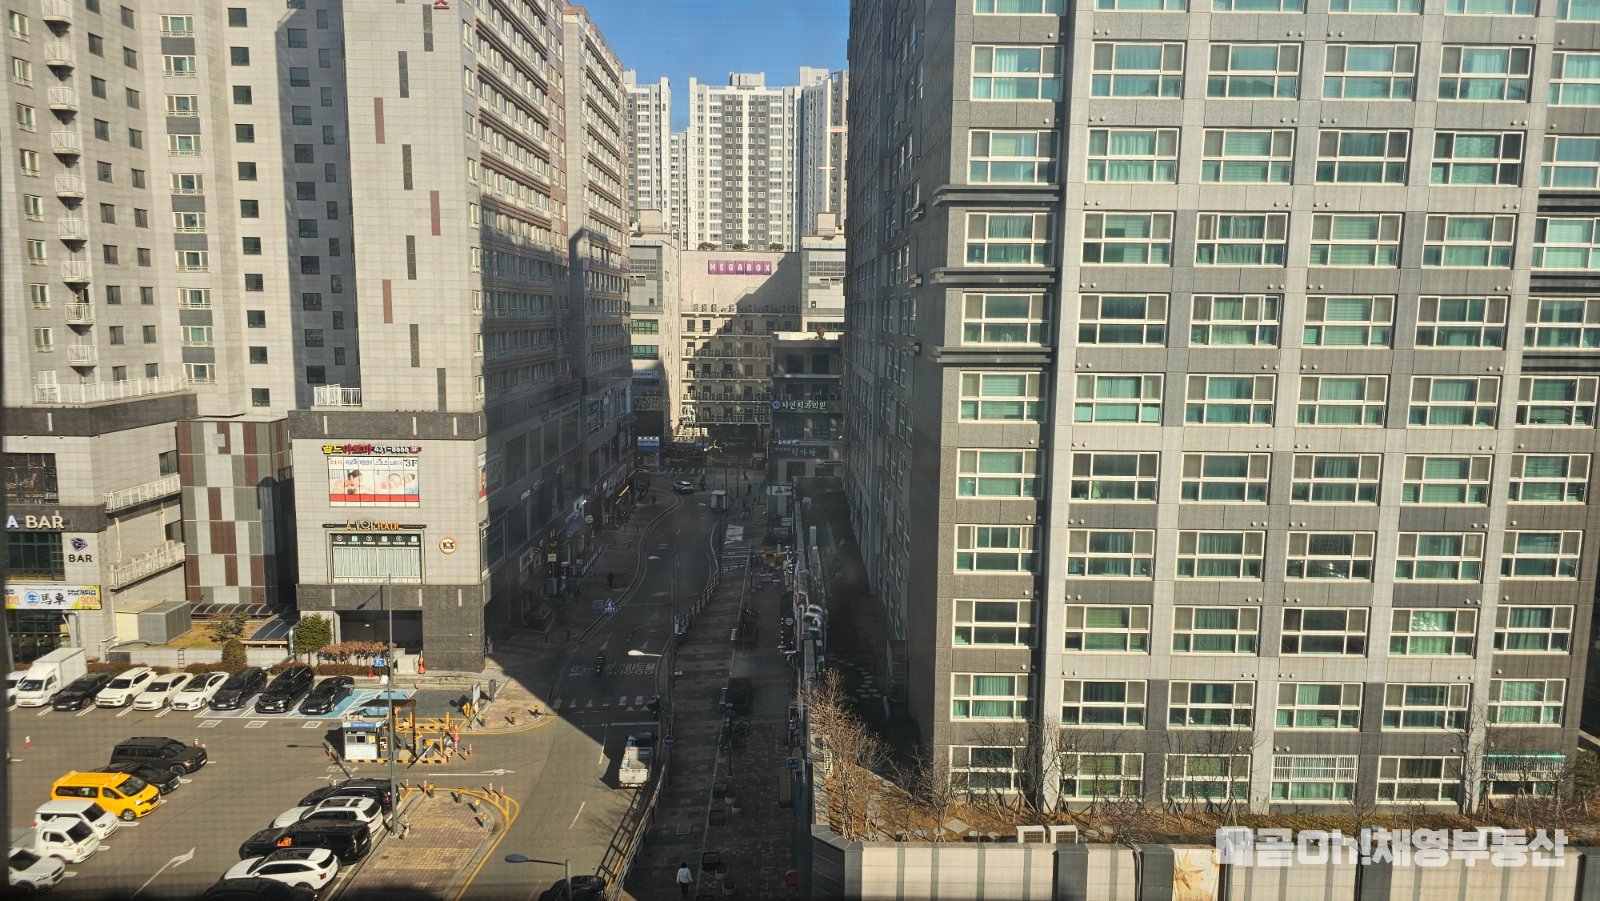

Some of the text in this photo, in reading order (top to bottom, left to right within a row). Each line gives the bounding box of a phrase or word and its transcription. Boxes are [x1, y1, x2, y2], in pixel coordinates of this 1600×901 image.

[709, 263, 771, 272] MEGABOX
[25, 515, 65, 529] BAR
[68, 554, 93, 563] BAR
